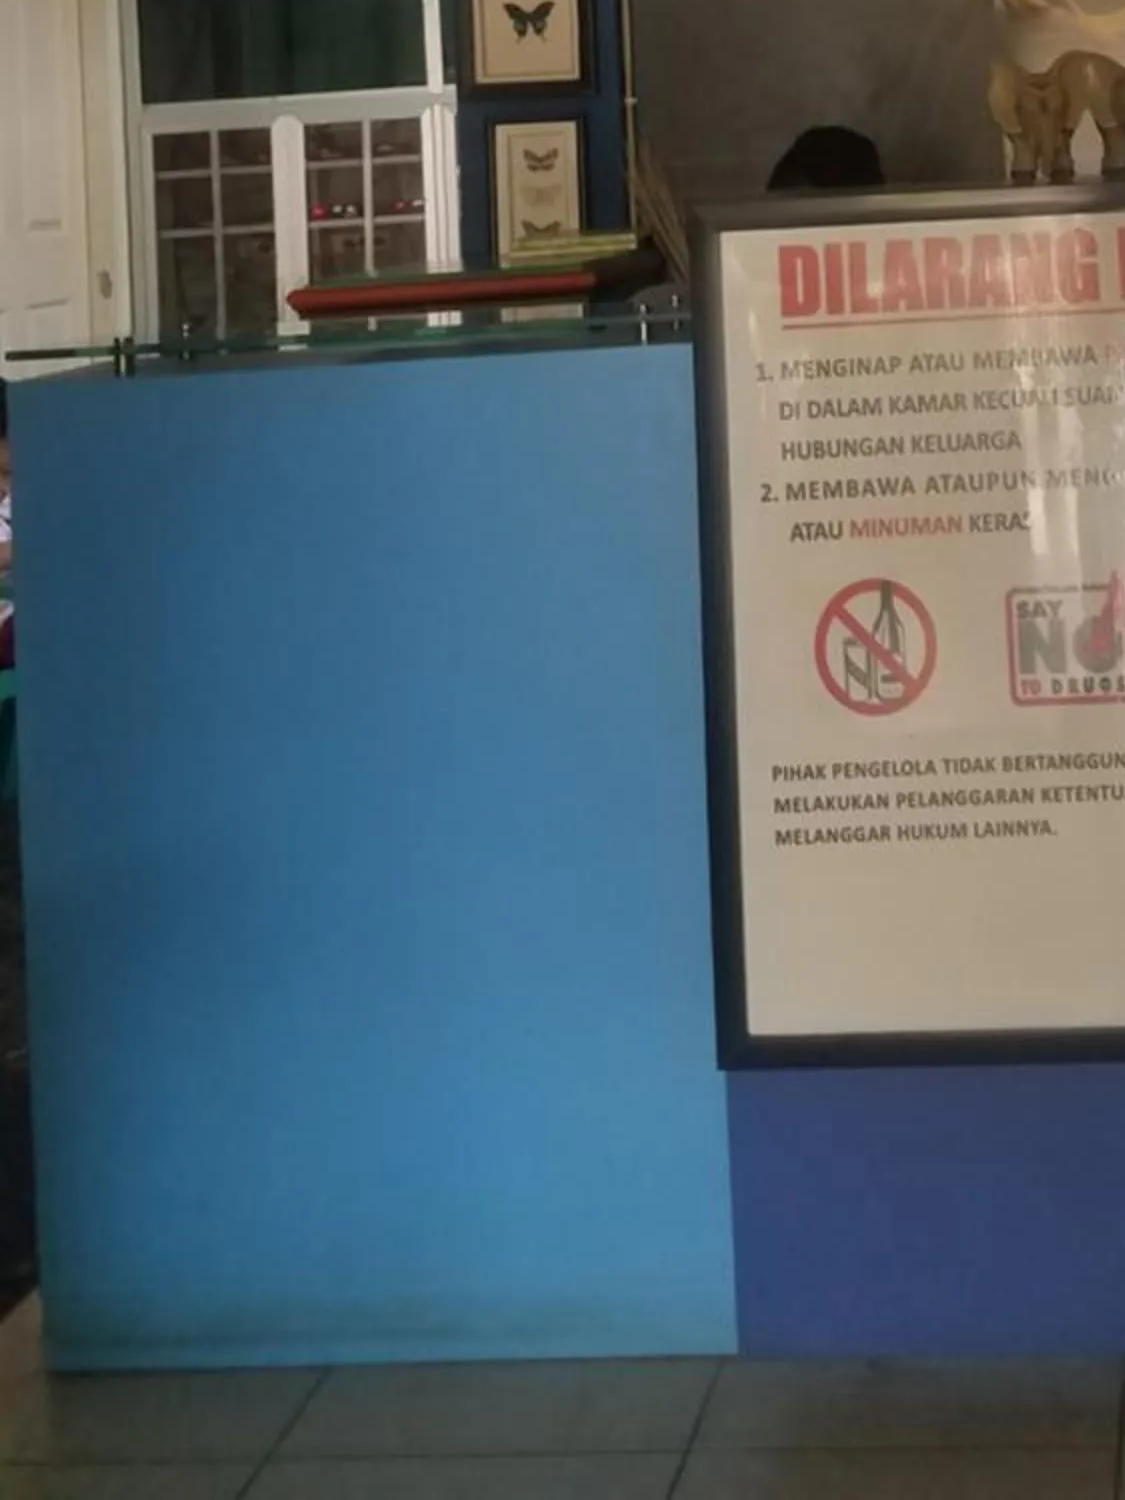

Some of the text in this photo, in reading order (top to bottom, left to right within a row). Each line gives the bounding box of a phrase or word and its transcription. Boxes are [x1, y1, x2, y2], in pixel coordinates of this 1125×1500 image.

[778, 228, 1099, 317] DILARANG
[755, 362, 775, 382] 1.
[781, 355, 902, 380] MENGINAP
[909, 352, 965, 373] ATAU
[973, 344, 1098, 370] MEMBAWA
[779, 401, 800, 420] DI
[807, 396, 882, 420] DALAM
[889, 392, 969, 415] KAMAR
[973, 387, 1058, 411] KECUALI
[781, 430, 1023, 461] HUBUNGAN KELUARGA
[760, 483, 780, 502] 2.
[785, 476, 917, 501] MEMBAWA
[925, 470, 1036, 495] ATAUPUN
[790, 520, 844, 543] ATAU
[850, 515, 963, 538] MINUMAN
[1016, 599, 1063, 619] SAY
[1019, 616, 1123, 674] NO
[1020, 678, 1042, 695] TO
[772, 763, 827, 782] PIHAK
[832, 758, 938, 780] PENGELOLA
[943, 755, 997, 775] TIDAK
[773, 792, 890, 814] MELAKUKAN
[896, 786, 1035, 809] PELANGGARAN
[775, 819, 1058, 847] MELANGGAR HUKUM LAINNYA.
